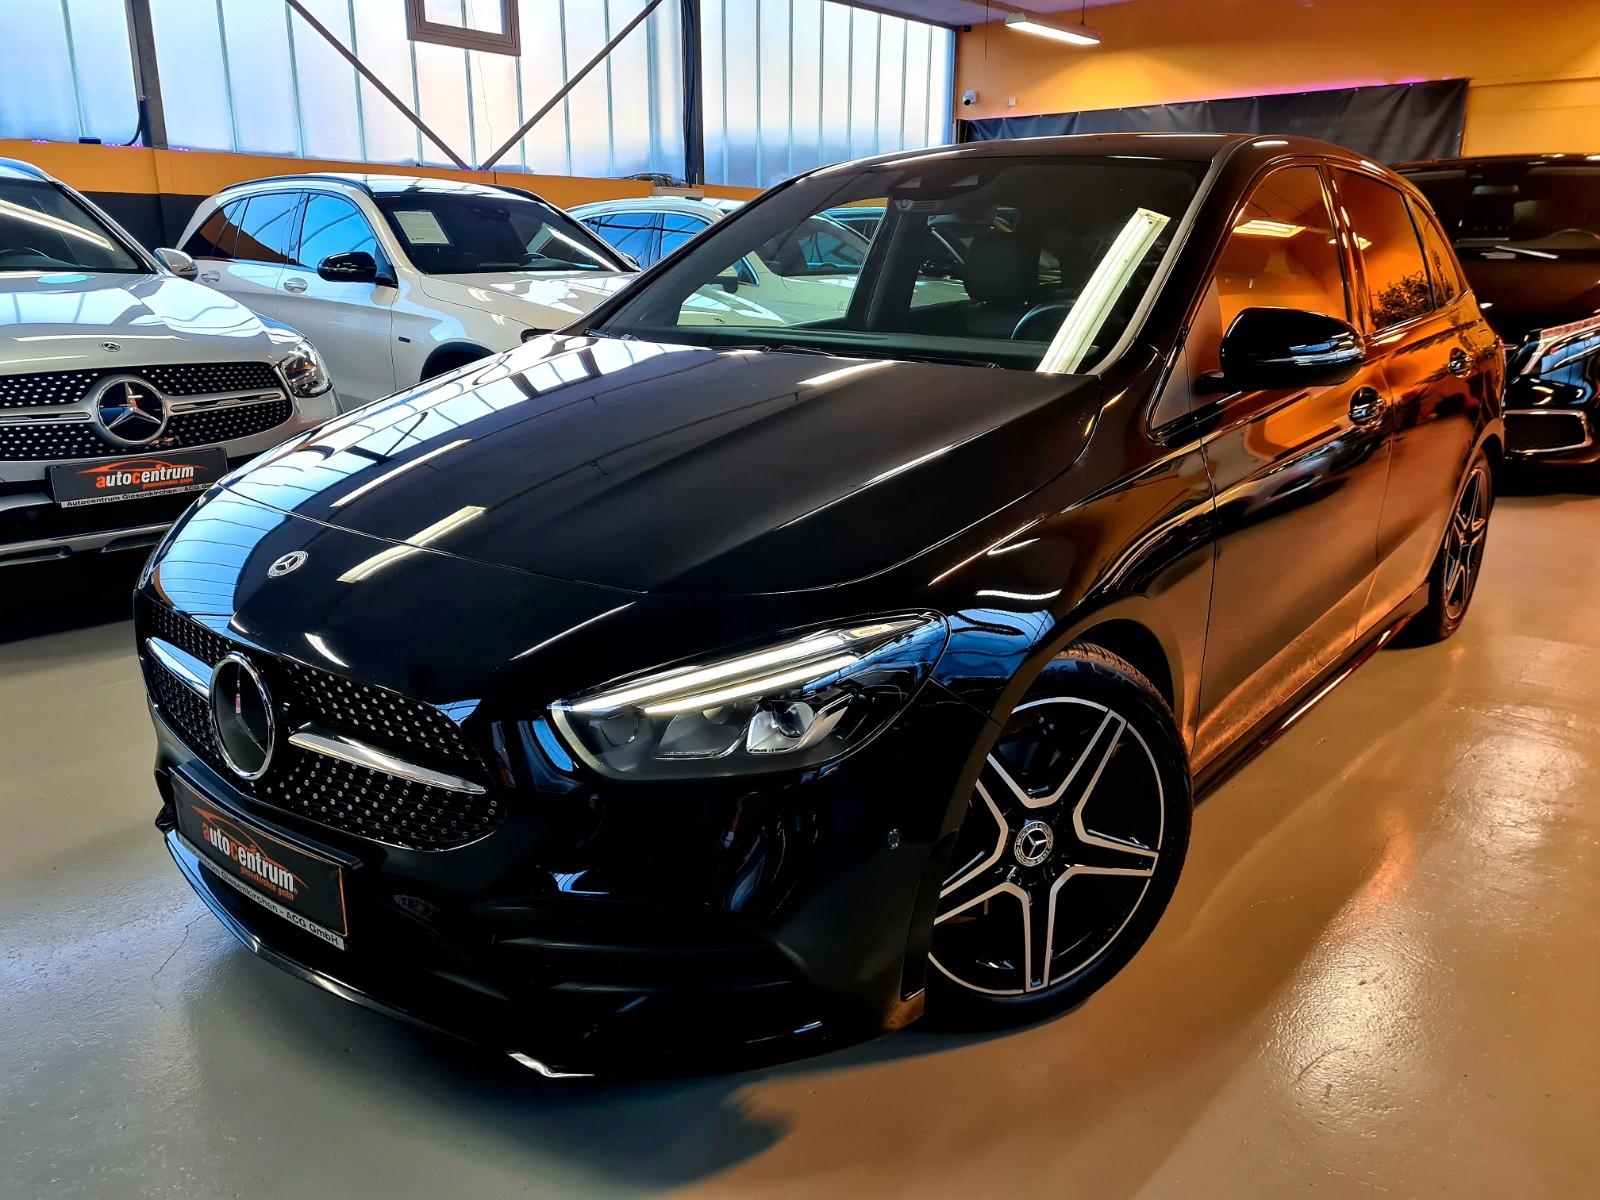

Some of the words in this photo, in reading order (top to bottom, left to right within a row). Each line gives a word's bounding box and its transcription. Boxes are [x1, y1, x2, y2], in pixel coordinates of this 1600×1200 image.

[95, 465, 194, 489] autocentrum
[202, 822, 295, 892] autocentrum
[286, 911, 307, 928] ACG
[309, 922, 339, 947] GmbH
